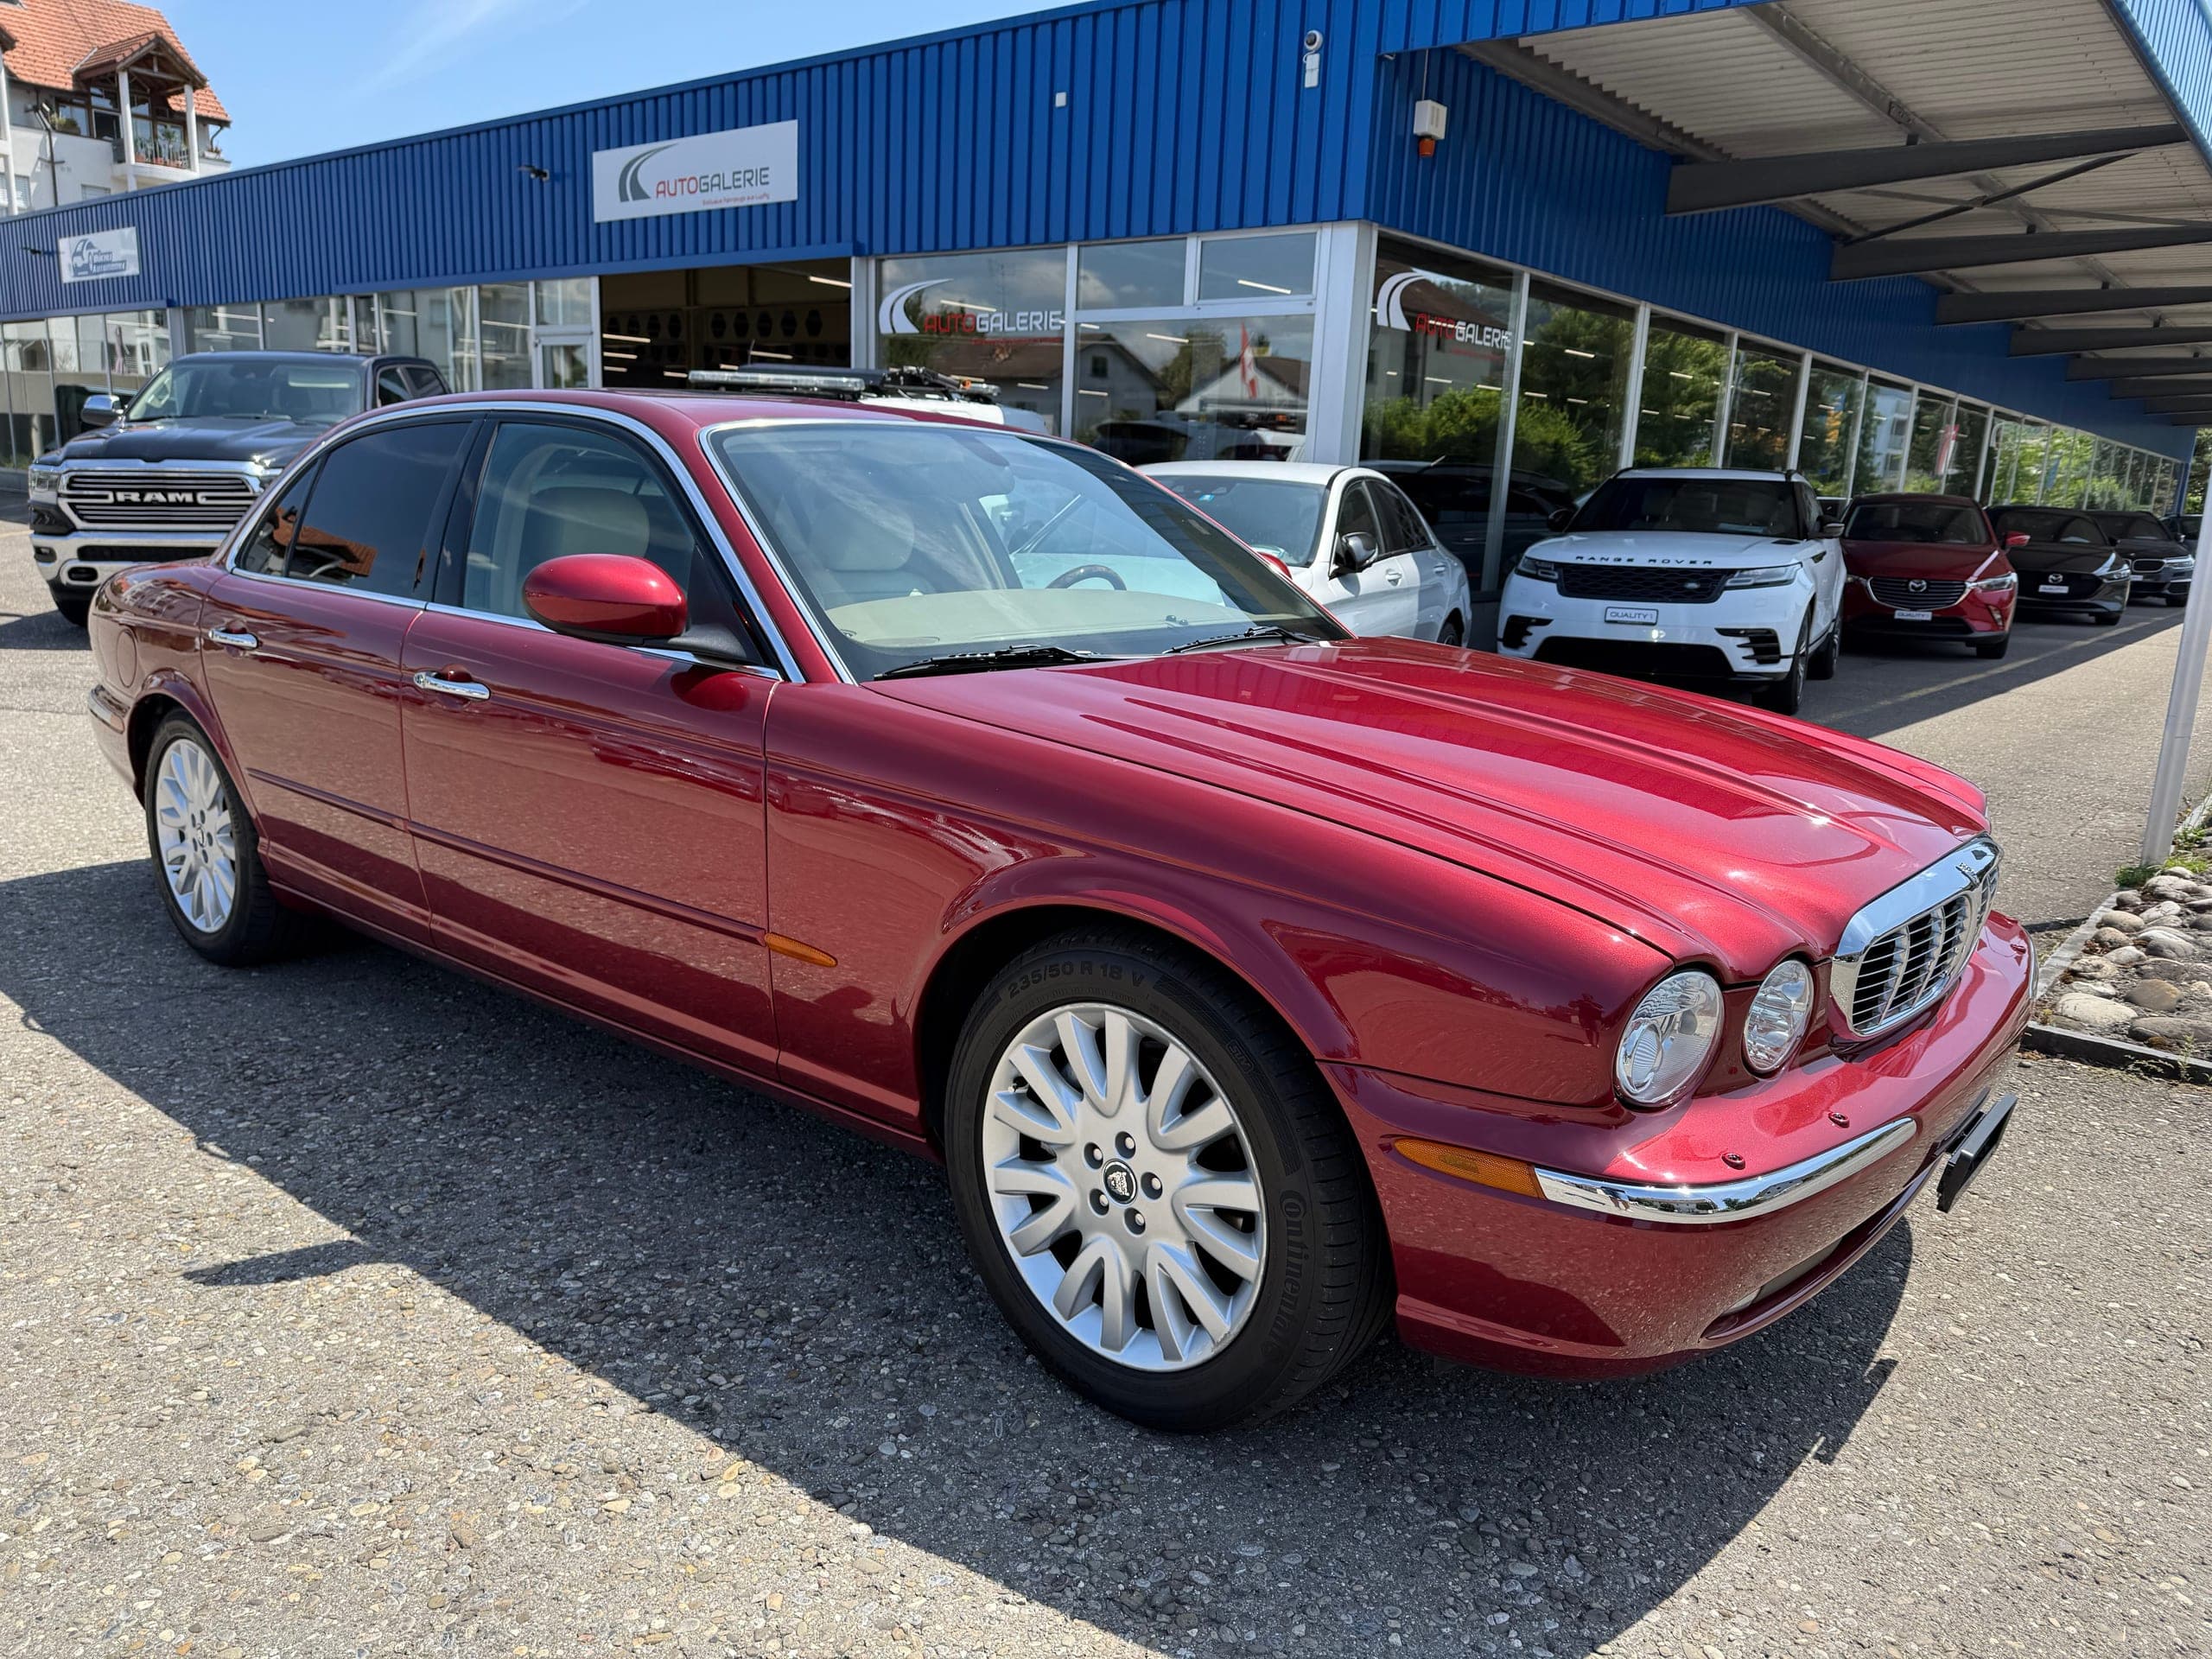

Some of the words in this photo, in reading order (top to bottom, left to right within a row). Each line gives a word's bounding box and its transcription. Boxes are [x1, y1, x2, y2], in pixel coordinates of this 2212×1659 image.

[656, 167, 770, 199] AUTOGALERIE
[924, 310, 1062, 334] AUTOGALERIE
[1414, 312, 1513, 350] AUTOGALERIE
[116, 491, 194, 503] RAM
[1007, 961, 1074, 996] 235/50
[1080, 960, 1093, 976] R
[1100, 962, 1122, 980] 18
[1131, 969, 1145, 987] V
